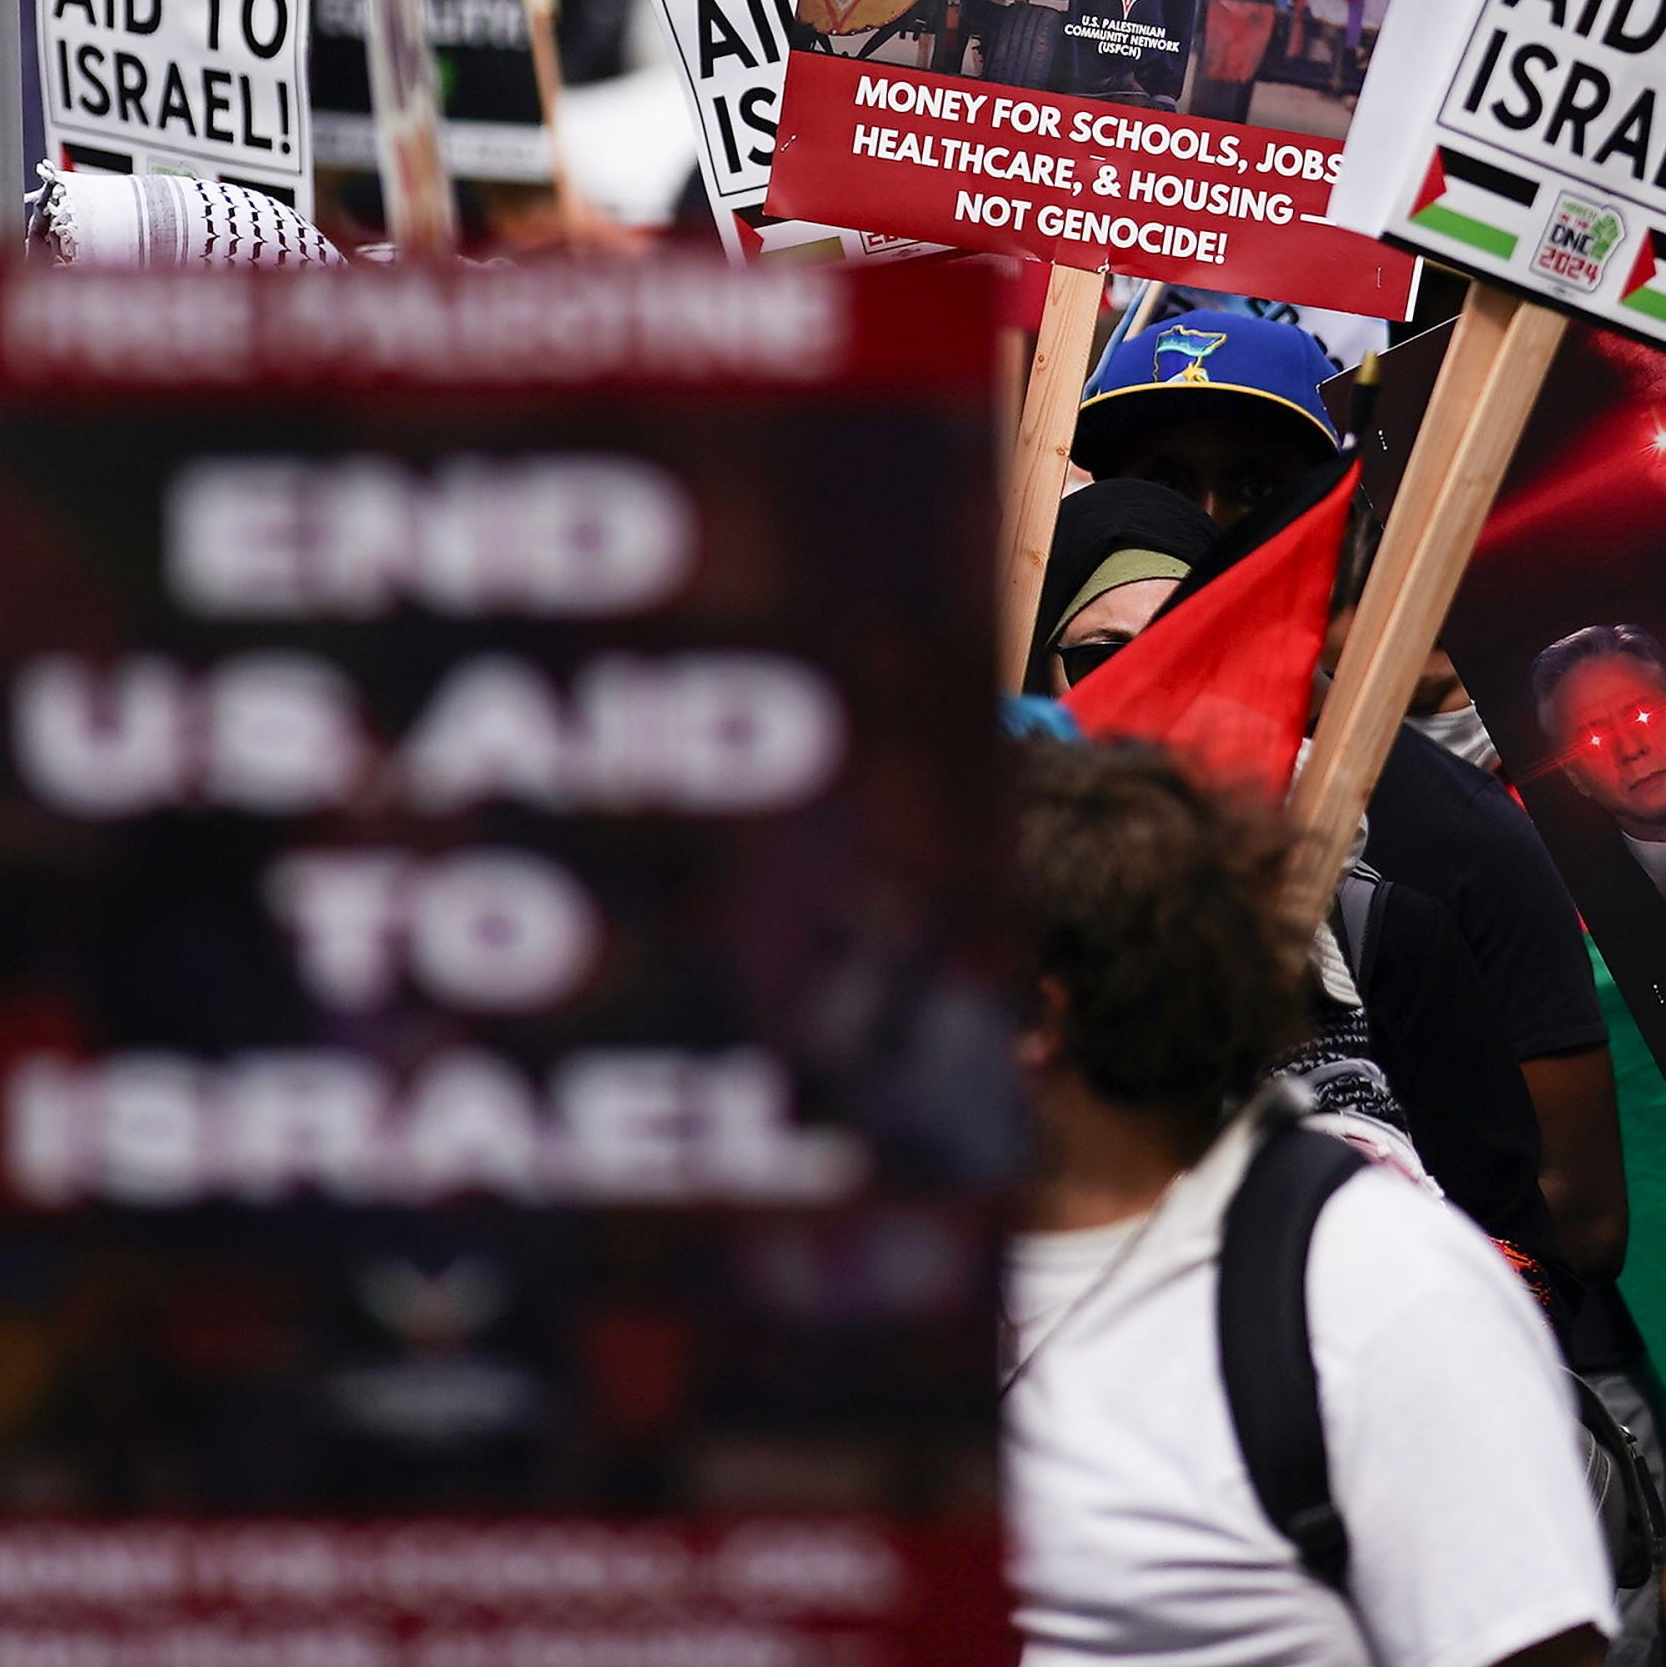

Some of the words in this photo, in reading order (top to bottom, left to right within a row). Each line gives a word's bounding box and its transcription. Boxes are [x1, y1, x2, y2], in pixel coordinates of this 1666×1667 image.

[1064, 24, 1129, 44] COMMUNITY
[1130, 34, 1181, 53] NETWORK
[1082, 15, 1100, 28] U.S.
[1102, 18, 1166, 38] PALESTINIAN
[1098, 41, 1142, 60] (USPCN)
[57, 37, 293, 155] ISRAEL!
[854, 75, 985, 127] MONEY
[993, 97, 1061, 137] FOR
[1068, 111, 1249, 175] SCHOOLS,
[852, 124, 1083, 194] HEALTHCARE,
[1098, 165, 1121, 196] &
[1128, 170, 1294, 226] HOUSING
[954, 192, 1034, 236] NOT
[1040, 205, 1228, 265] GENOCIDE!
[1539, 245, 1599, 285] 2024
[159, 452, 698, 620] END
[398, 648, 848, 821] AID
[261, 844, 603, 1018] TO
